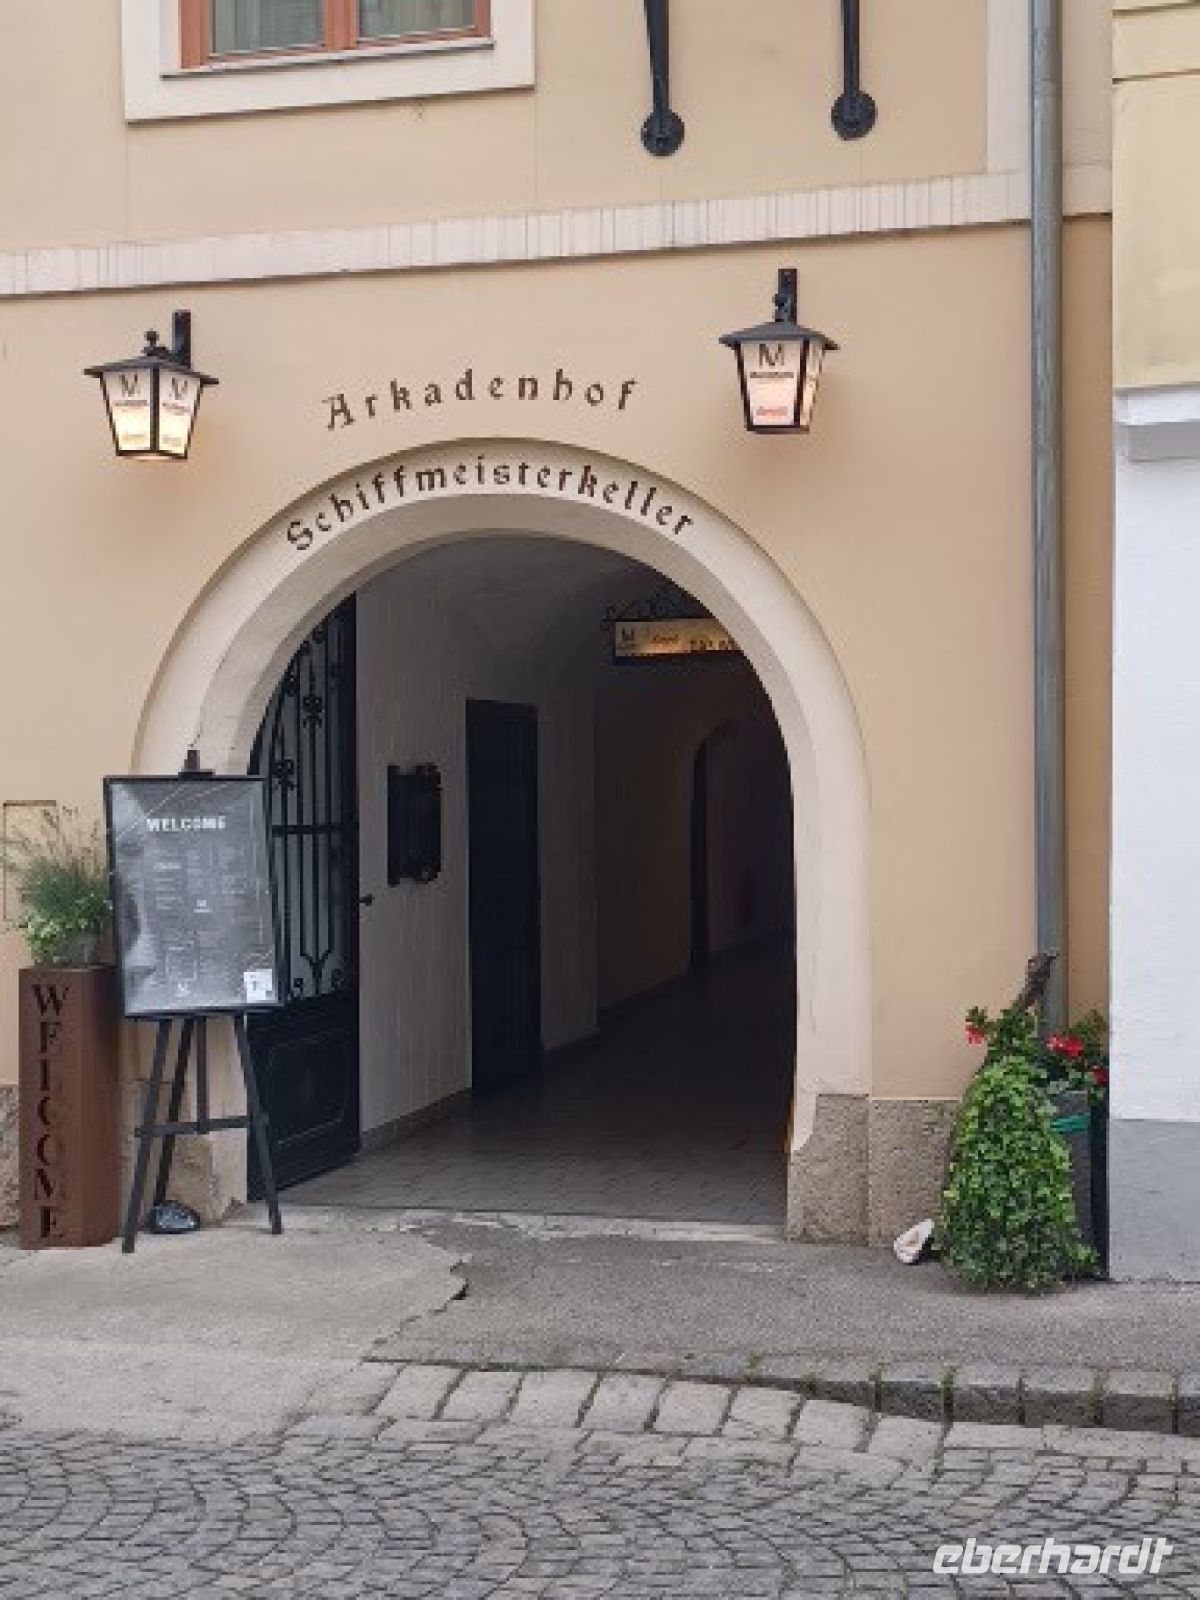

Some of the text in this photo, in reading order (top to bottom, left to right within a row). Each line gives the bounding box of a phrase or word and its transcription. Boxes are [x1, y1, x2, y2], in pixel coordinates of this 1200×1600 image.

[323, 368, 638, 430] Arkadenhof
[287, 455, 694, 550] Schiffmeisterkeller
[146, 815, 227, 833] WELCOME
